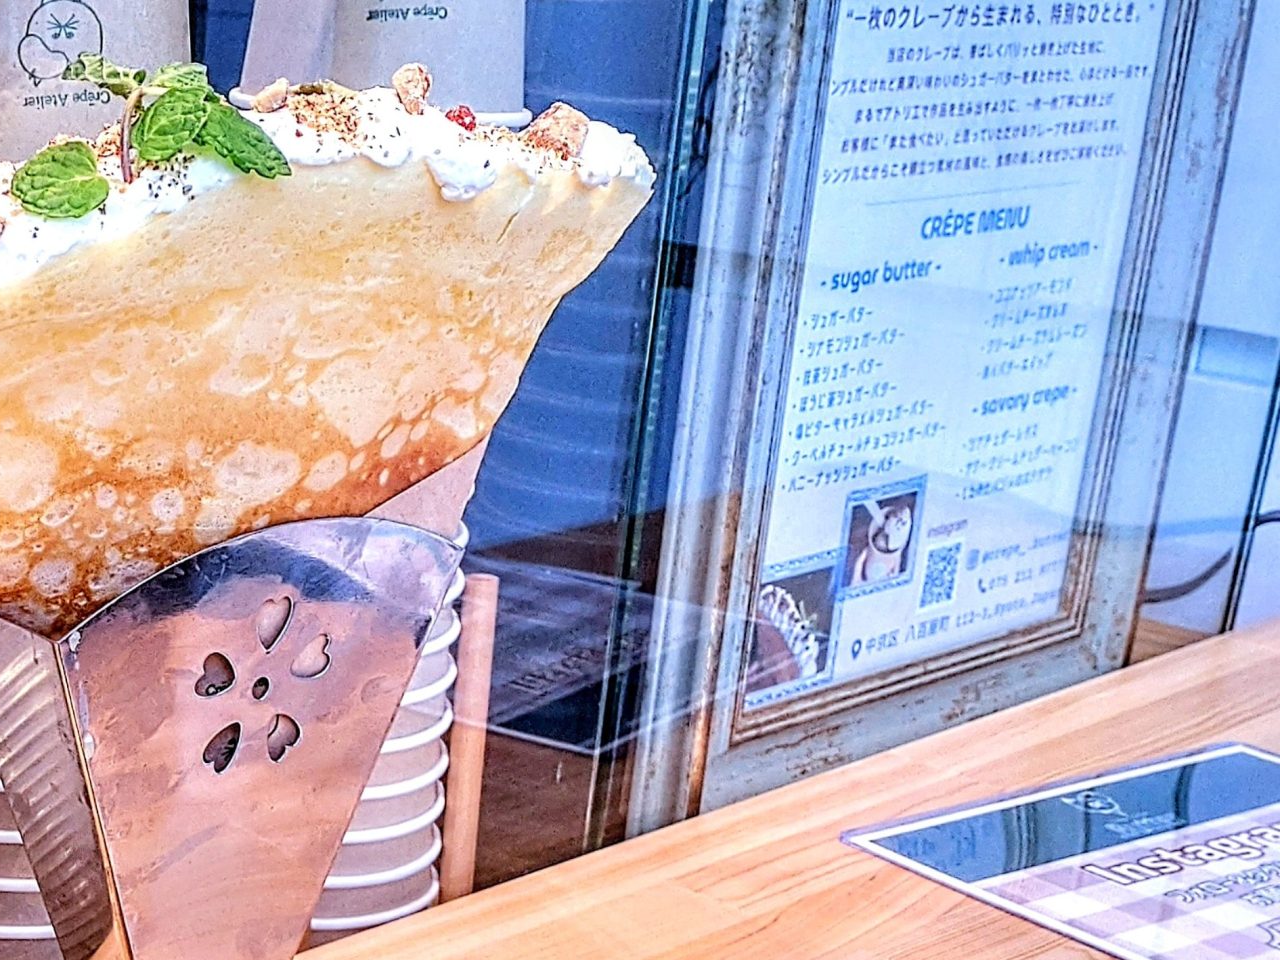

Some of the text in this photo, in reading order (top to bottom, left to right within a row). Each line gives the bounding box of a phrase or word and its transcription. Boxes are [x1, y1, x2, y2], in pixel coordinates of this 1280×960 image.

[22, 93, 68, 110] Atelier
[977, 205, 1031, 234] MENU
[1008, 240, 1091, 267] whip cream
[830, 259, 933, 294] sugar butter
[981, 393, 1030, 416] savory
